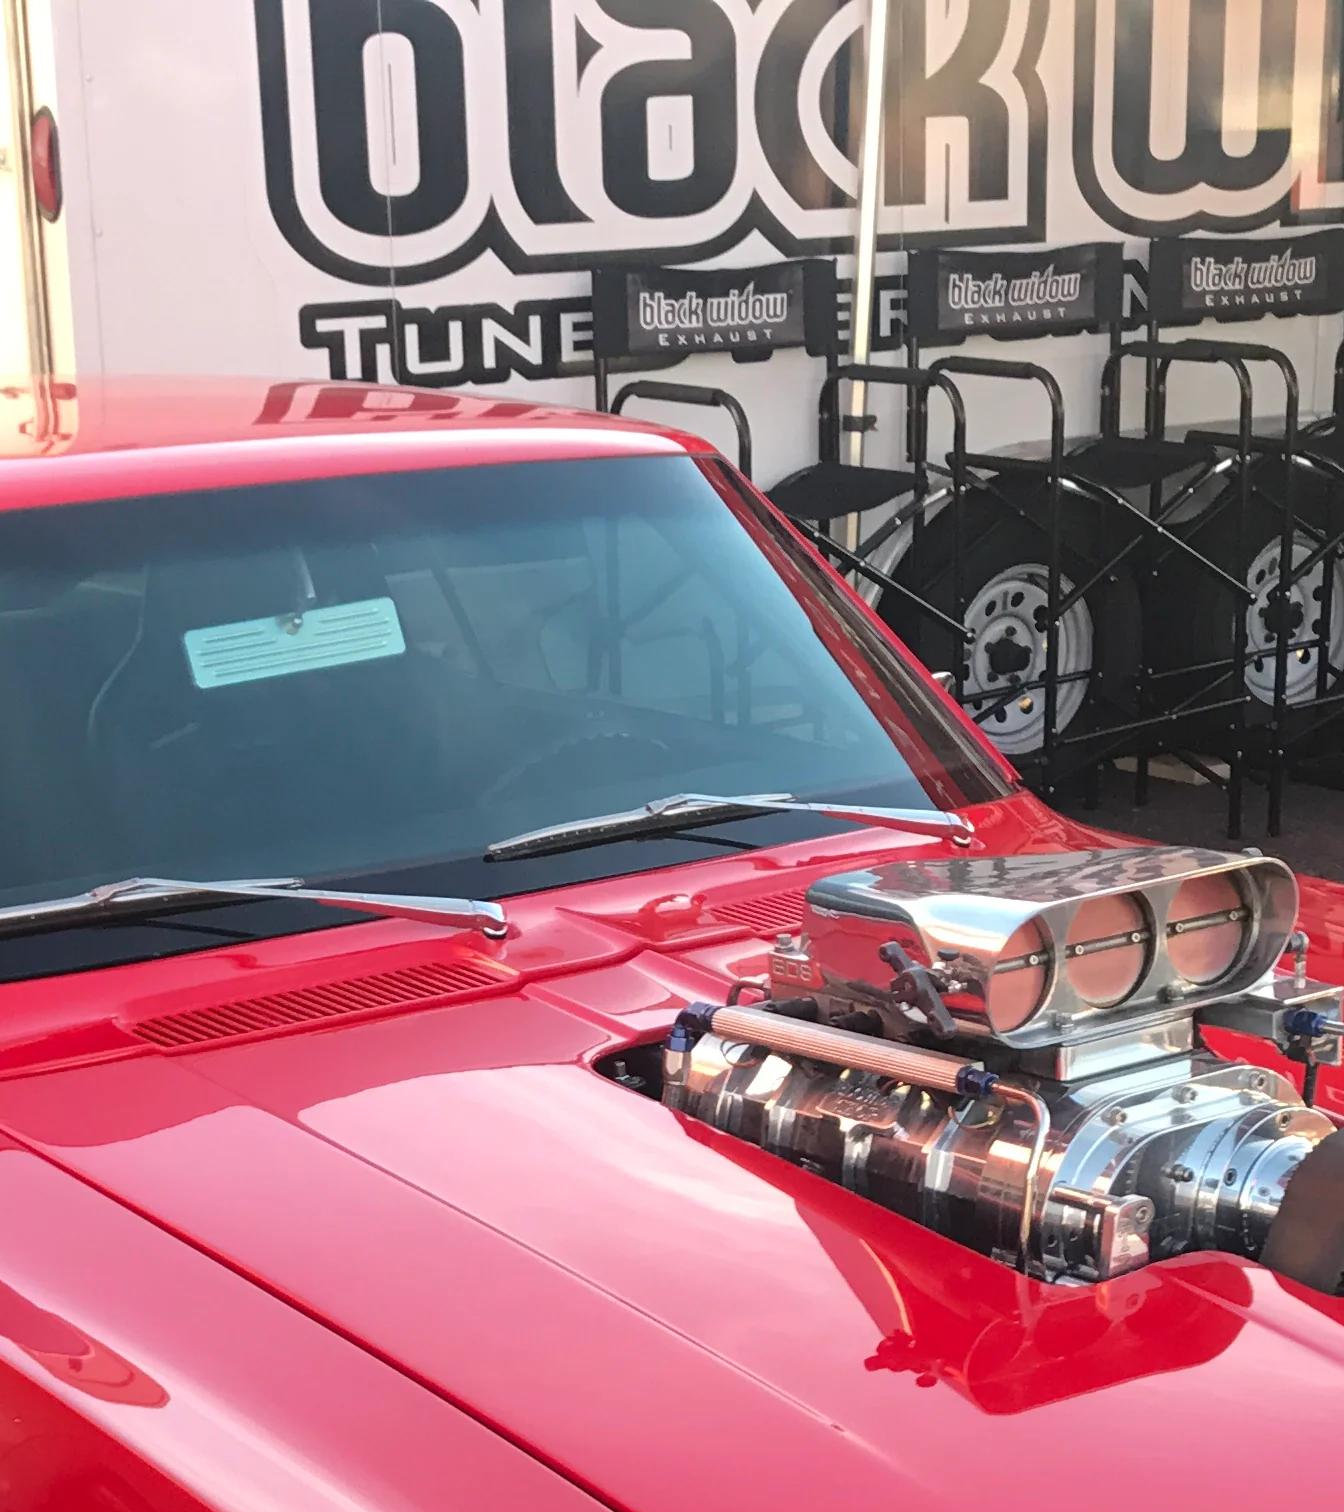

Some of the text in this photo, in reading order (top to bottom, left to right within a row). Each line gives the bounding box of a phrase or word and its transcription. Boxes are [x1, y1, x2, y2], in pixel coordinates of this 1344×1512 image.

[949, 273, 1007, 309] black
[1008, 264, 1081, 306] widow
[1191, 256, 1247, 291] black
[1248, 246, 1316, 288] widow
[640, 291, 703, 330] black
[706, 281, 787, 326] widow
[964, 307, 1066, 325] EXHAUST
[1205, 290, 1302, 306] EXHAUST
[299, 296, 594, 388] TUNE
[658, 328, 773, 346] EXHAUST
